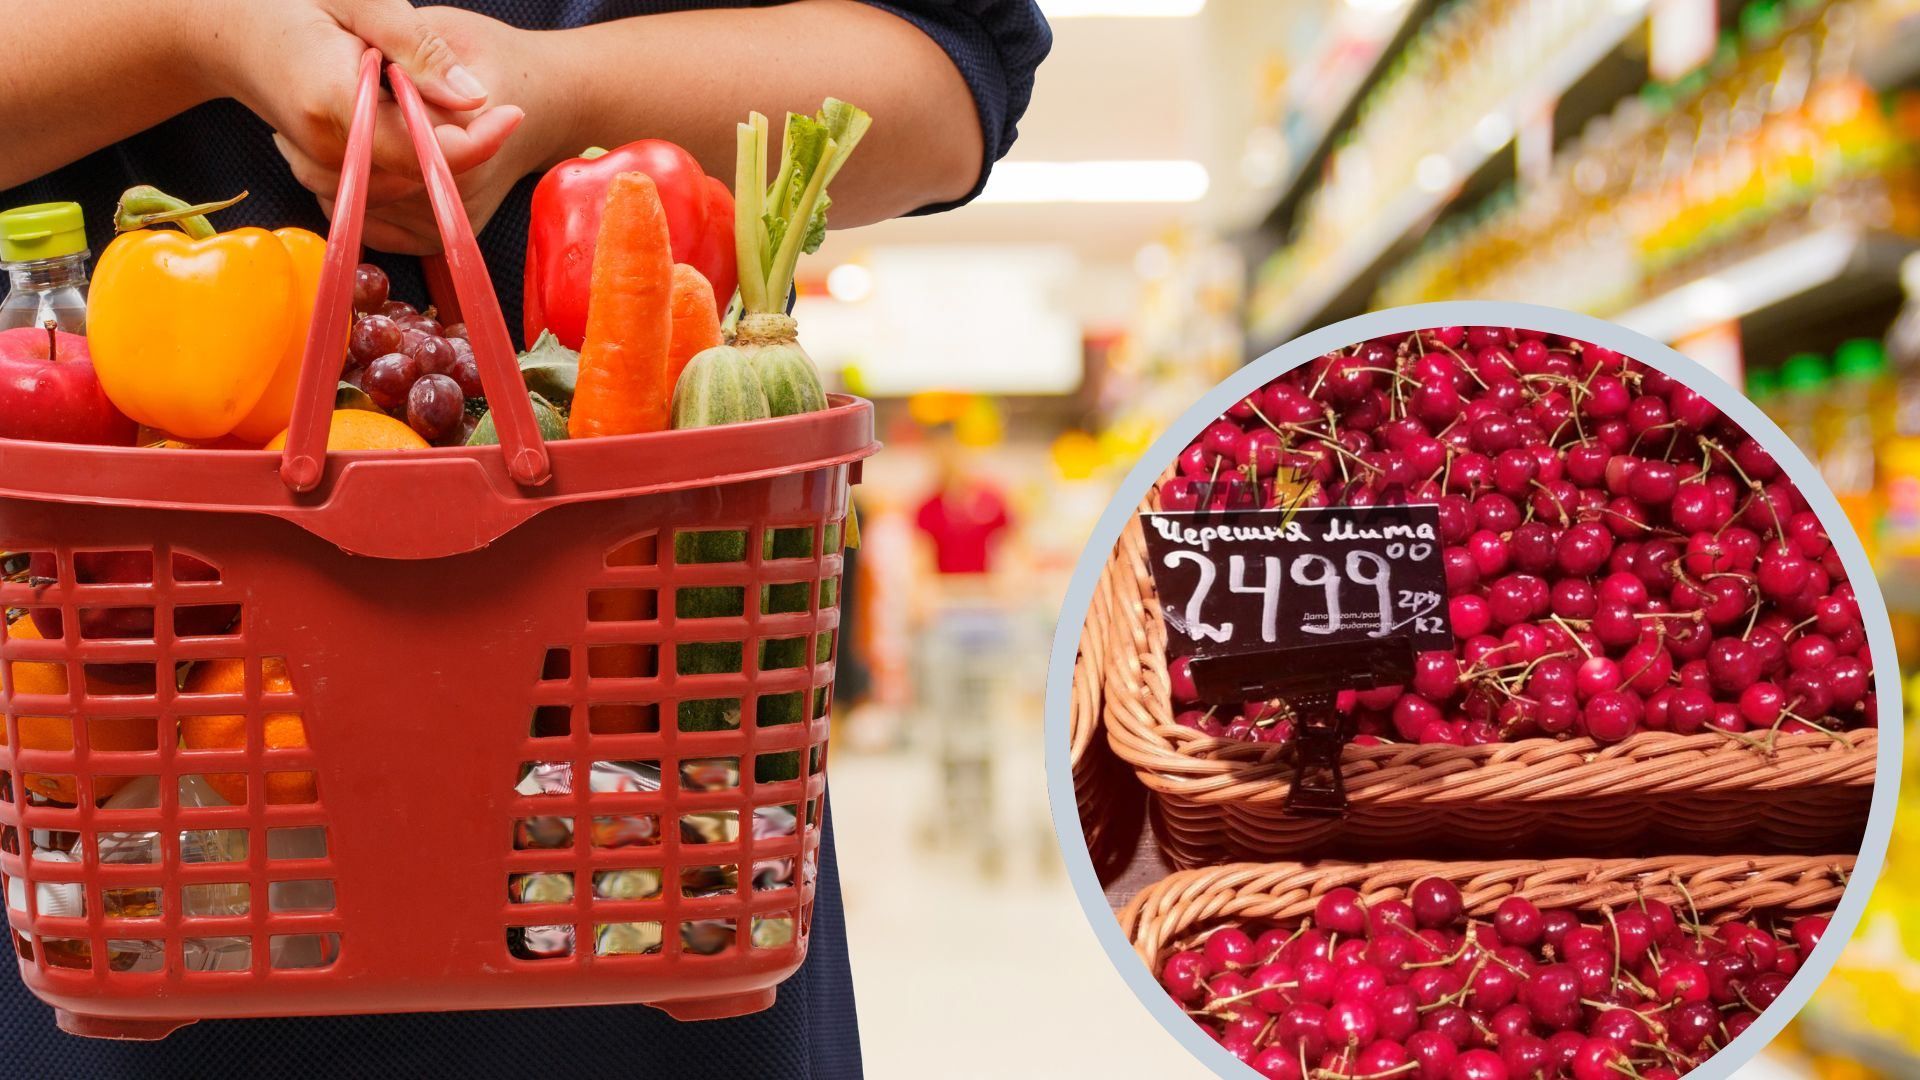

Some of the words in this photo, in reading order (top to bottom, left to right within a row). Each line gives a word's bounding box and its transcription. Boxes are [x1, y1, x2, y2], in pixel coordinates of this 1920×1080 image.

[1151, 516, 1311, 551] Черешня
[1323, 518, 1436, 541] Мита
[1163, 550, 1393, 642] 2499
[1386, 543, 1432, 562] 00
